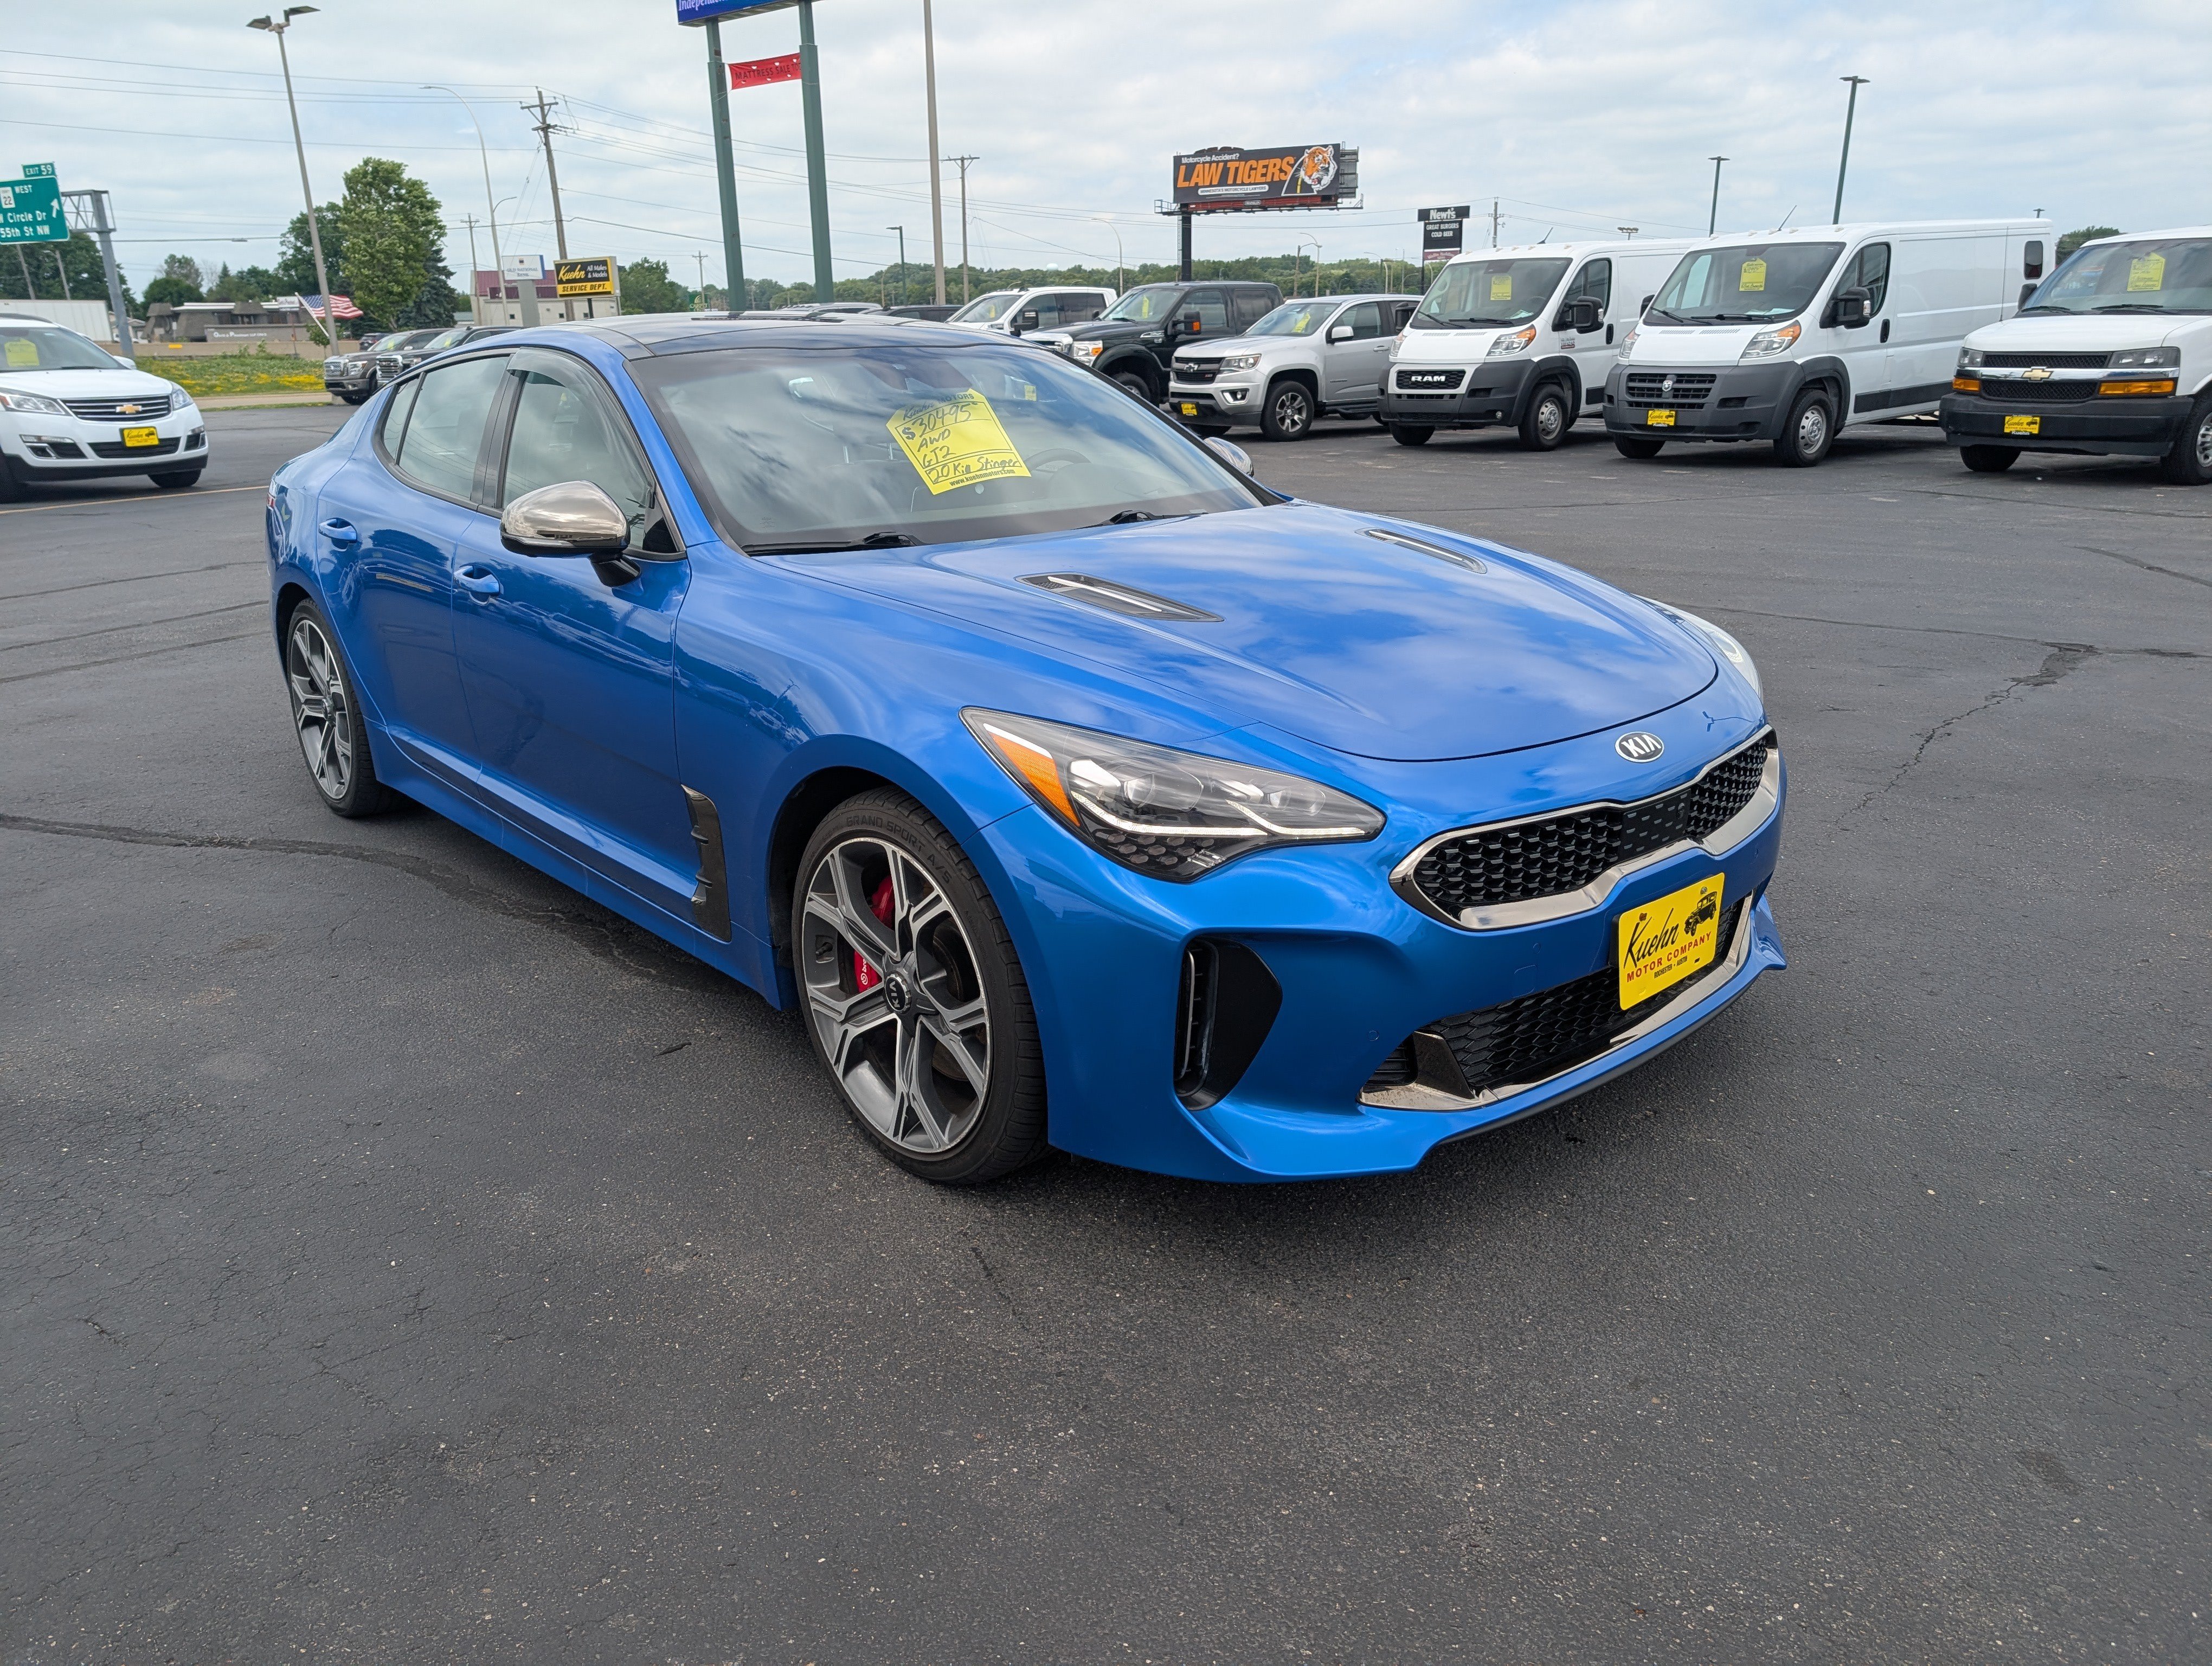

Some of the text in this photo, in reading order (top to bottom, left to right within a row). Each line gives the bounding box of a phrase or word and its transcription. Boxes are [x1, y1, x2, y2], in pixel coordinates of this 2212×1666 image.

[735, 68, 774, 80] MATTRESS
[775, 65, 790, 74] SALE
[41, 165, 52, 175] 59
[1177, 156, 1295, 187] LAW TIGERS
[3, 196, 12, 205] 22
[14, 185, 33, 194] WEST
[7, 212, 33, 222] Circle
[35, 210, 47, 221] Dr
[1429, 207, 1456, 220] Newt's
[0, 225, 50, 238] 55th St NW
[558, 264, 586, 281] Kuehn
[562, 283, 607, 292] SERVICE DEPT.
[903, 394, 975, 421] Kuehn MOTORS
[917, 428, 950, 452] AWD
[923, 446, 956, 468] GT2
[928, 456, 1019, 484] 20 Kia Stinger
[949, 469, 1016, 486] www.kuehnmotors.com
[1621, 734, 1662, 757] KIA
[846, 815, 953, 884] GRAND SPORT A/S
[1623, 907, 1679, 970] Kuehn
[1626, 931, 1712, 983] MOTOR COMPANY
[1654, 955, 1687, 978] ROCHESTER AUSTIN
[889, 981, 901, 1007] KIA
